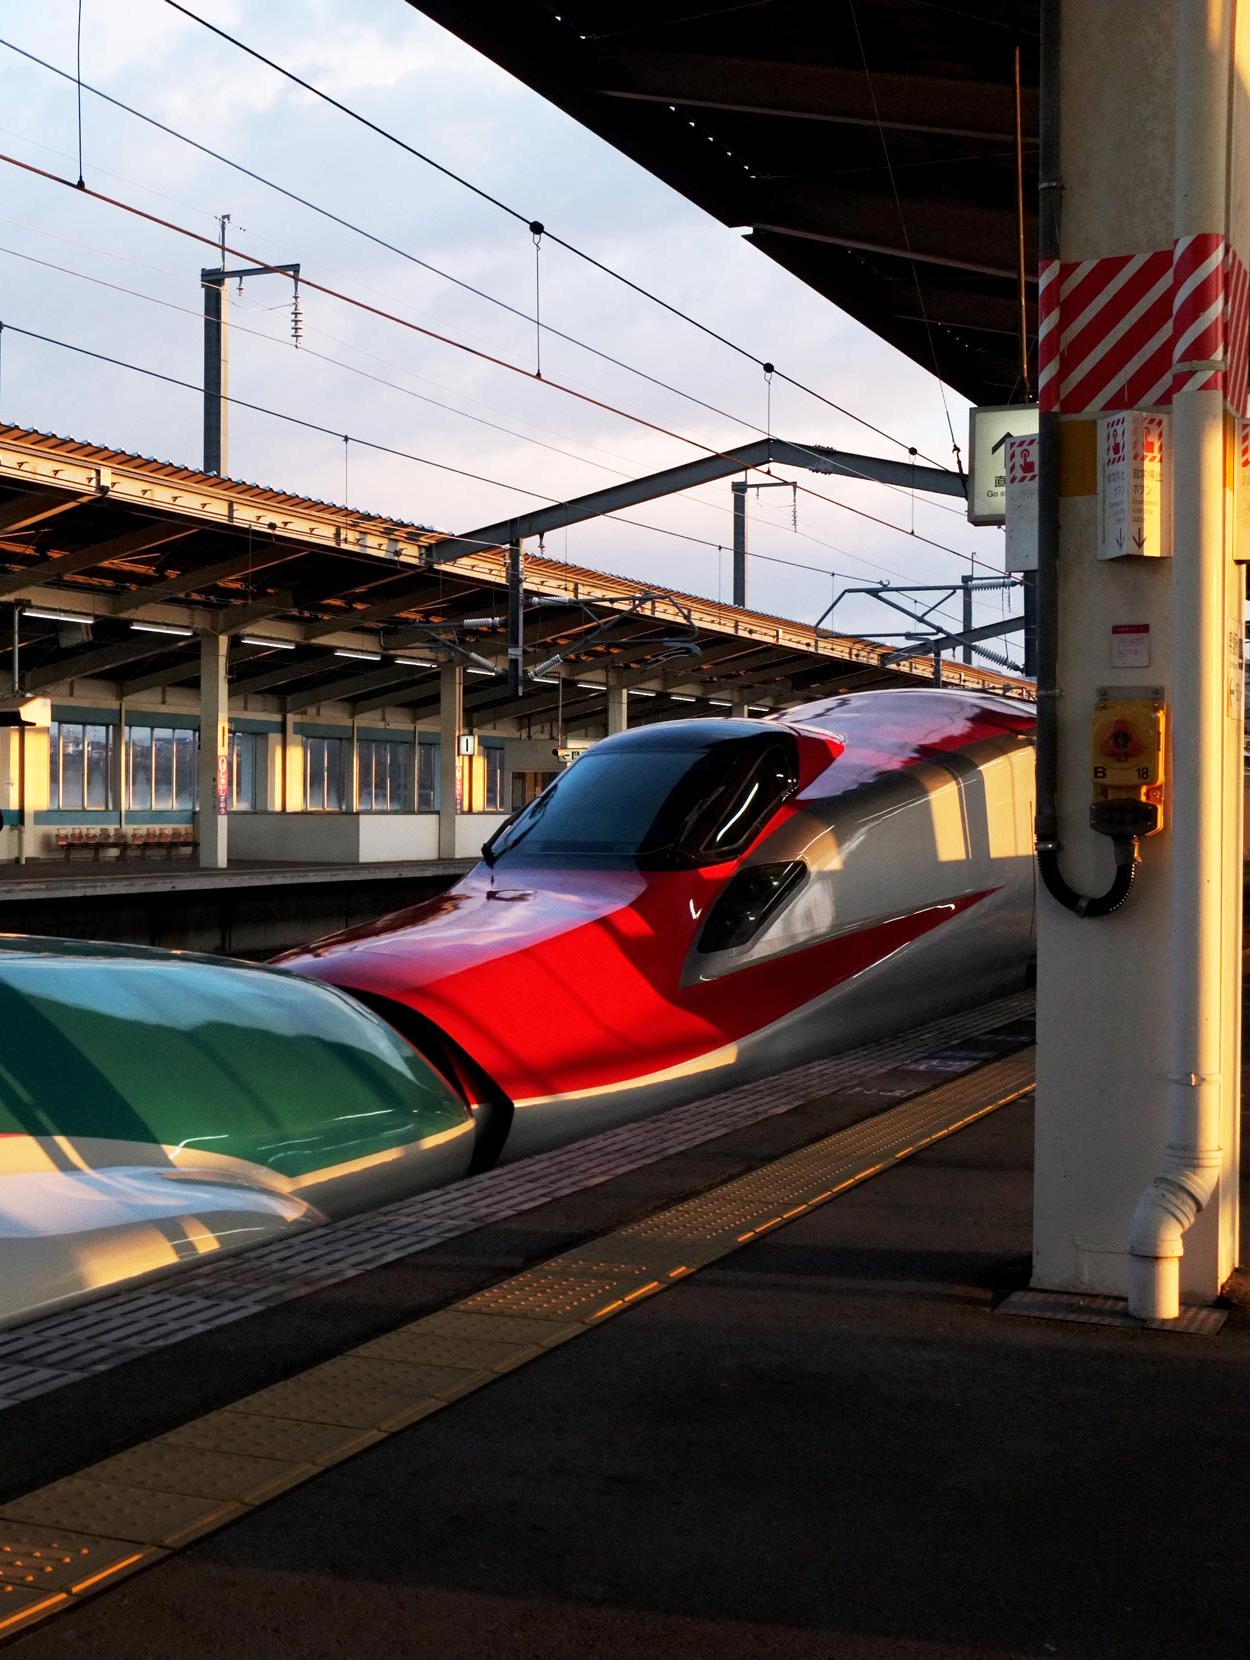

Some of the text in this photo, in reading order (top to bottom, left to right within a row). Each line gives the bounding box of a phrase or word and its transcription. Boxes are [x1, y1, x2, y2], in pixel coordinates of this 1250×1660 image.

[1132, 468, 1163, 482] 非常停止
[986, 490, 999, 498] Go
[1093, 766, 1149, 780] B 18
